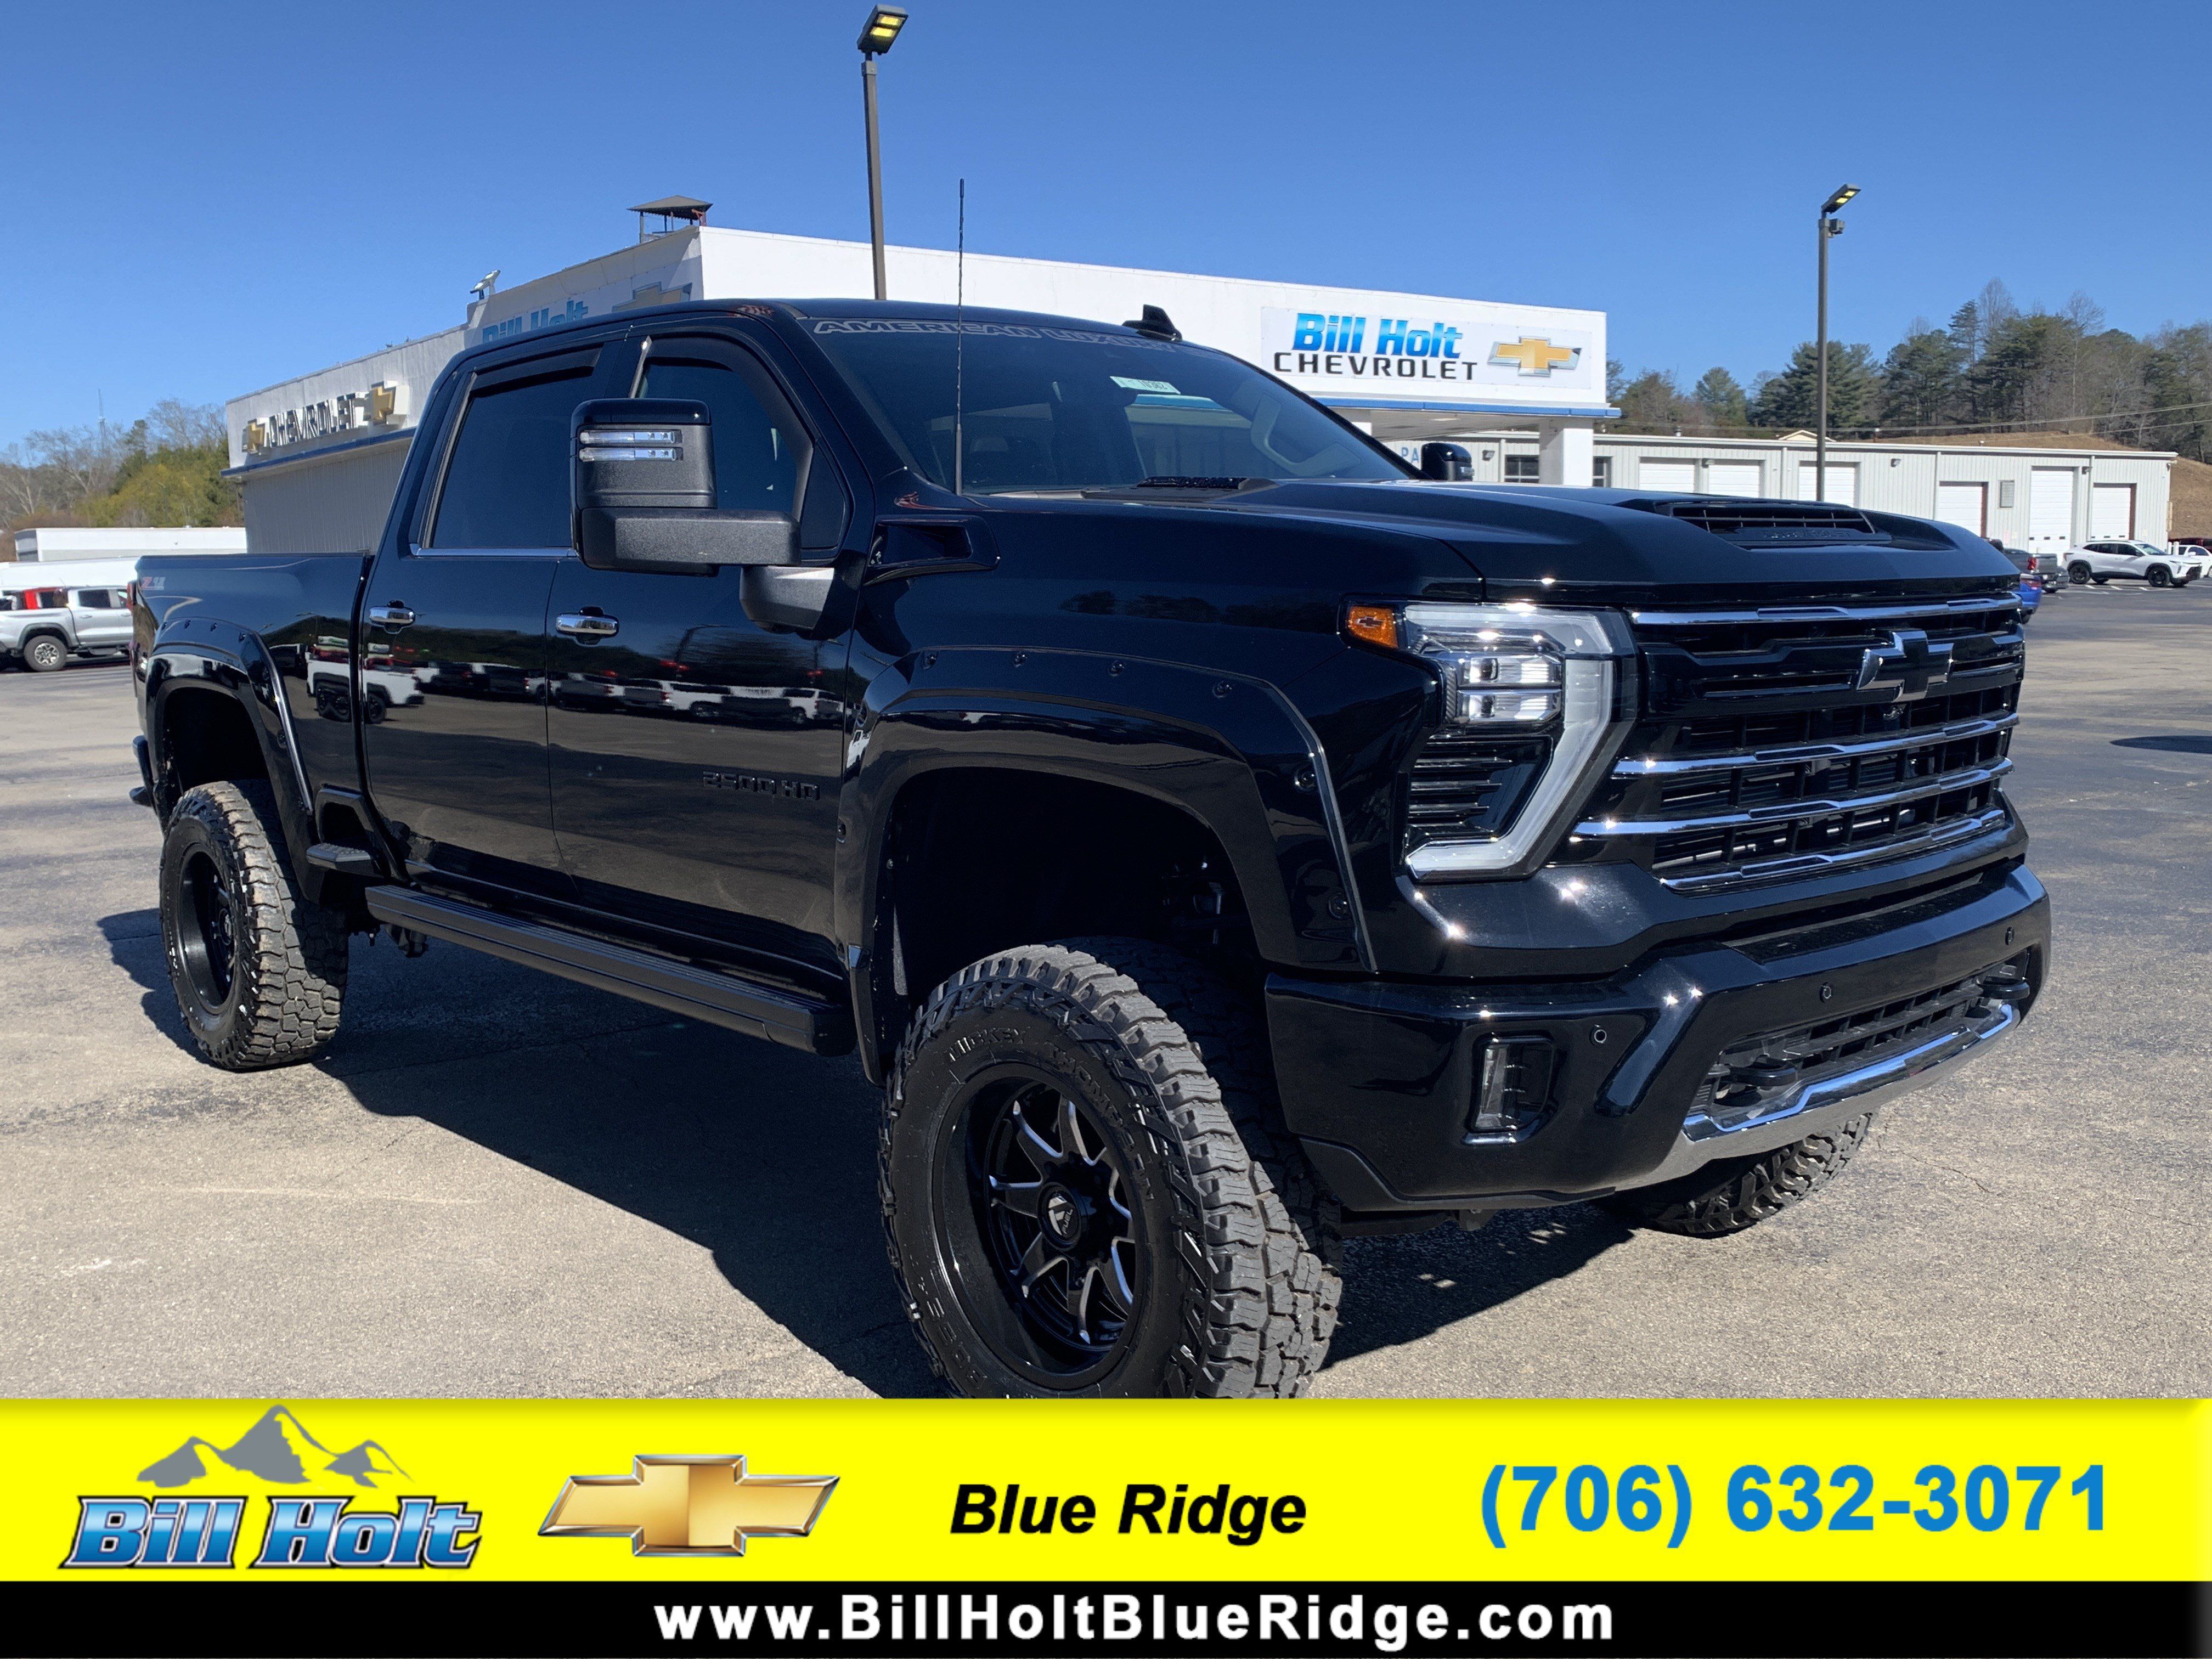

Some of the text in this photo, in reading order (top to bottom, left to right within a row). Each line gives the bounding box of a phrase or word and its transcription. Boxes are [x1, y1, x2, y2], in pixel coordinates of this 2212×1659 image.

[814, 320, 1042, 339] AMERICAN
[1292, 313, 1463, 359] Bill Holt
[1273, 352, 1478, 381] CHEVROLET
